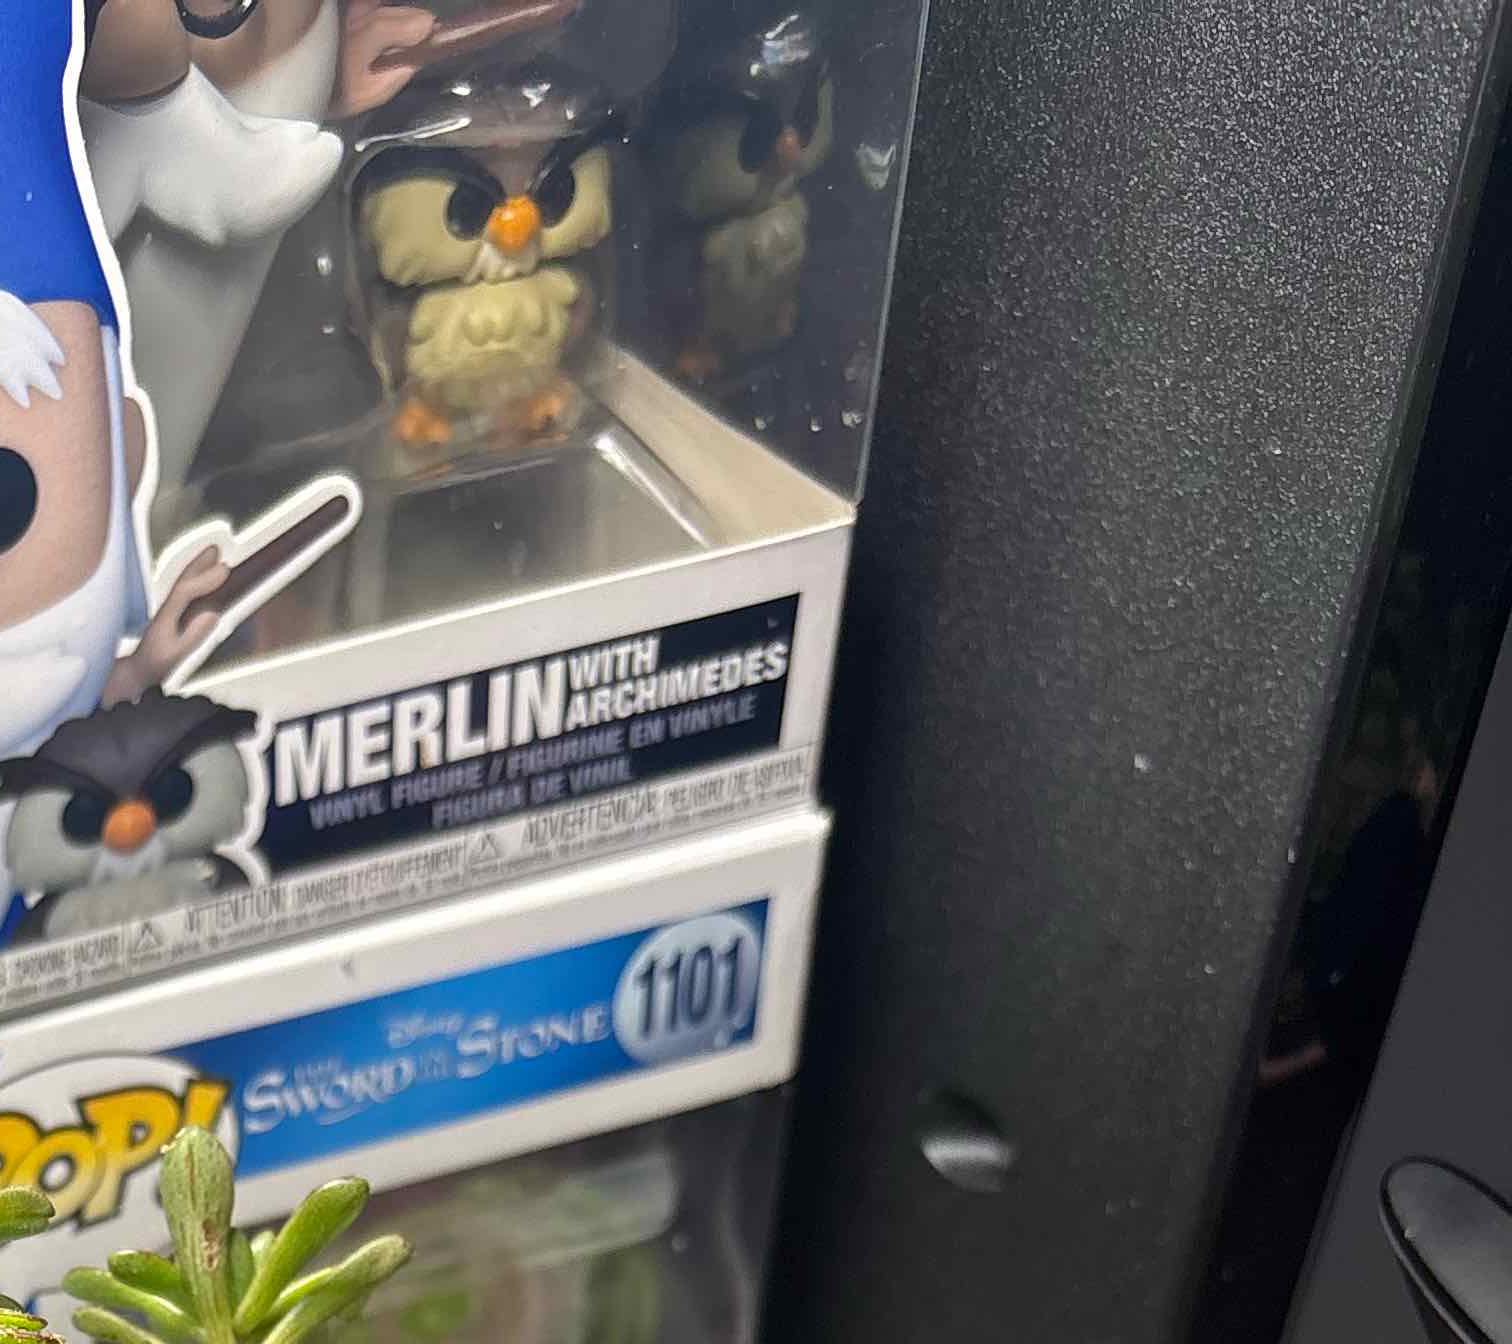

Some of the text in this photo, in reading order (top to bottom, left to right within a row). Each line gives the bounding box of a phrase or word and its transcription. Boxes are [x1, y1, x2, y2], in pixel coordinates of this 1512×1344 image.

[275, 658, 569, 808] MERLIN
[567, 636, 659, 692] WITH
[564, 641, 788, 732] ARCHIMEDES
[389, 767, 485, 811] FIGURE
[506, 725, 625, 780] FIGURINE
[629, 713, 667, 749] EN
[634, 933, 750, 1042] 1101
